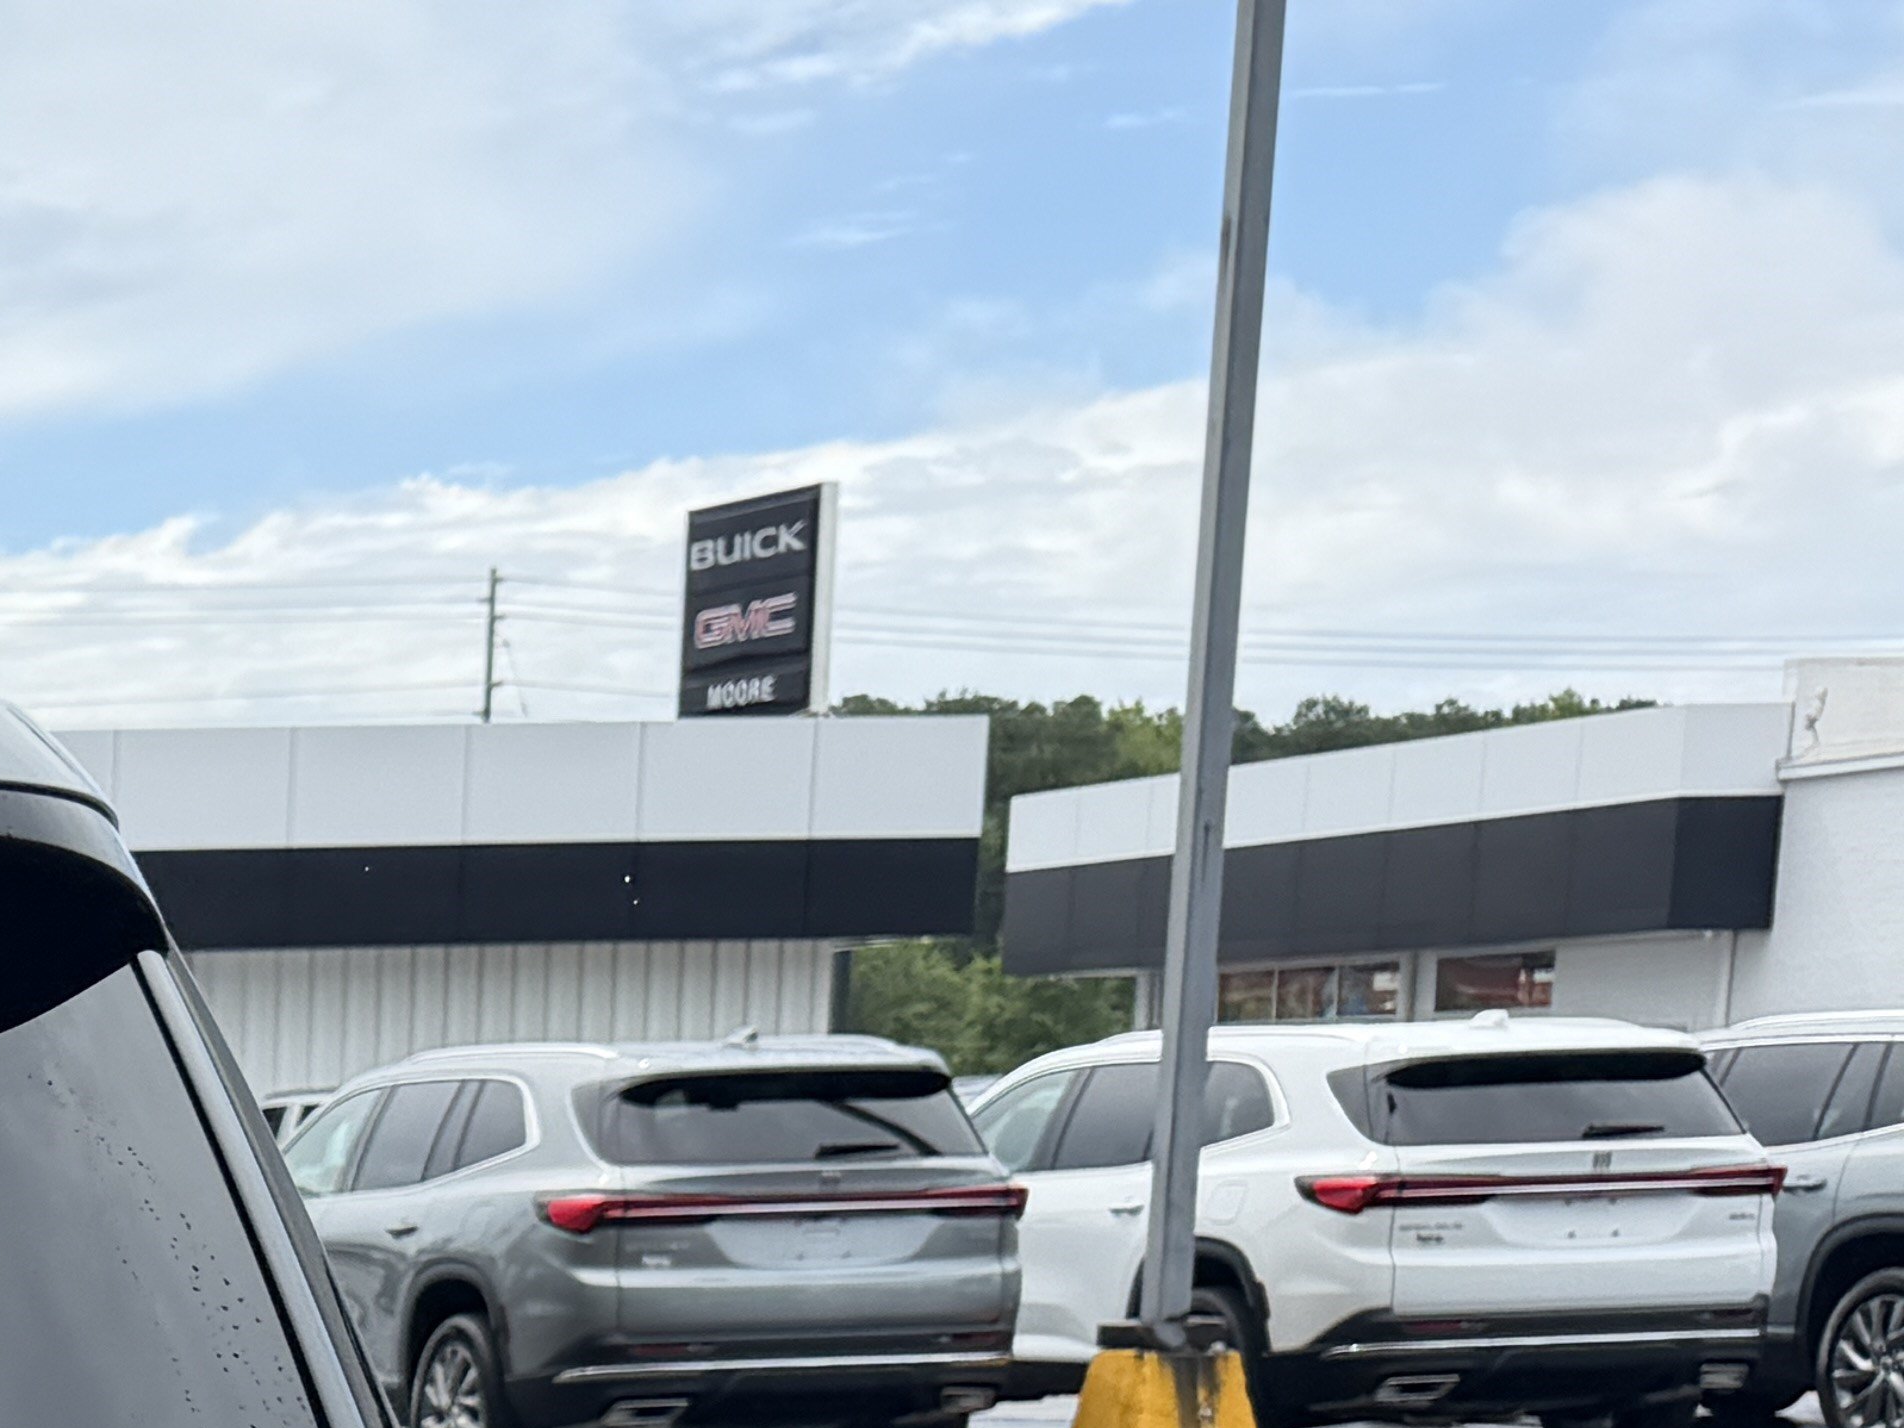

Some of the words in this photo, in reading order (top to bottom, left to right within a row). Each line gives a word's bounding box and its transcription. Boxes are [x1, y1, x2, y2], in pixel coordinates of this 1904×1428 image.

[690, 519, 808, 571] BUICK
[694, 591, 799, 650] GMC
[706, 674, 778, 711] MOORE
